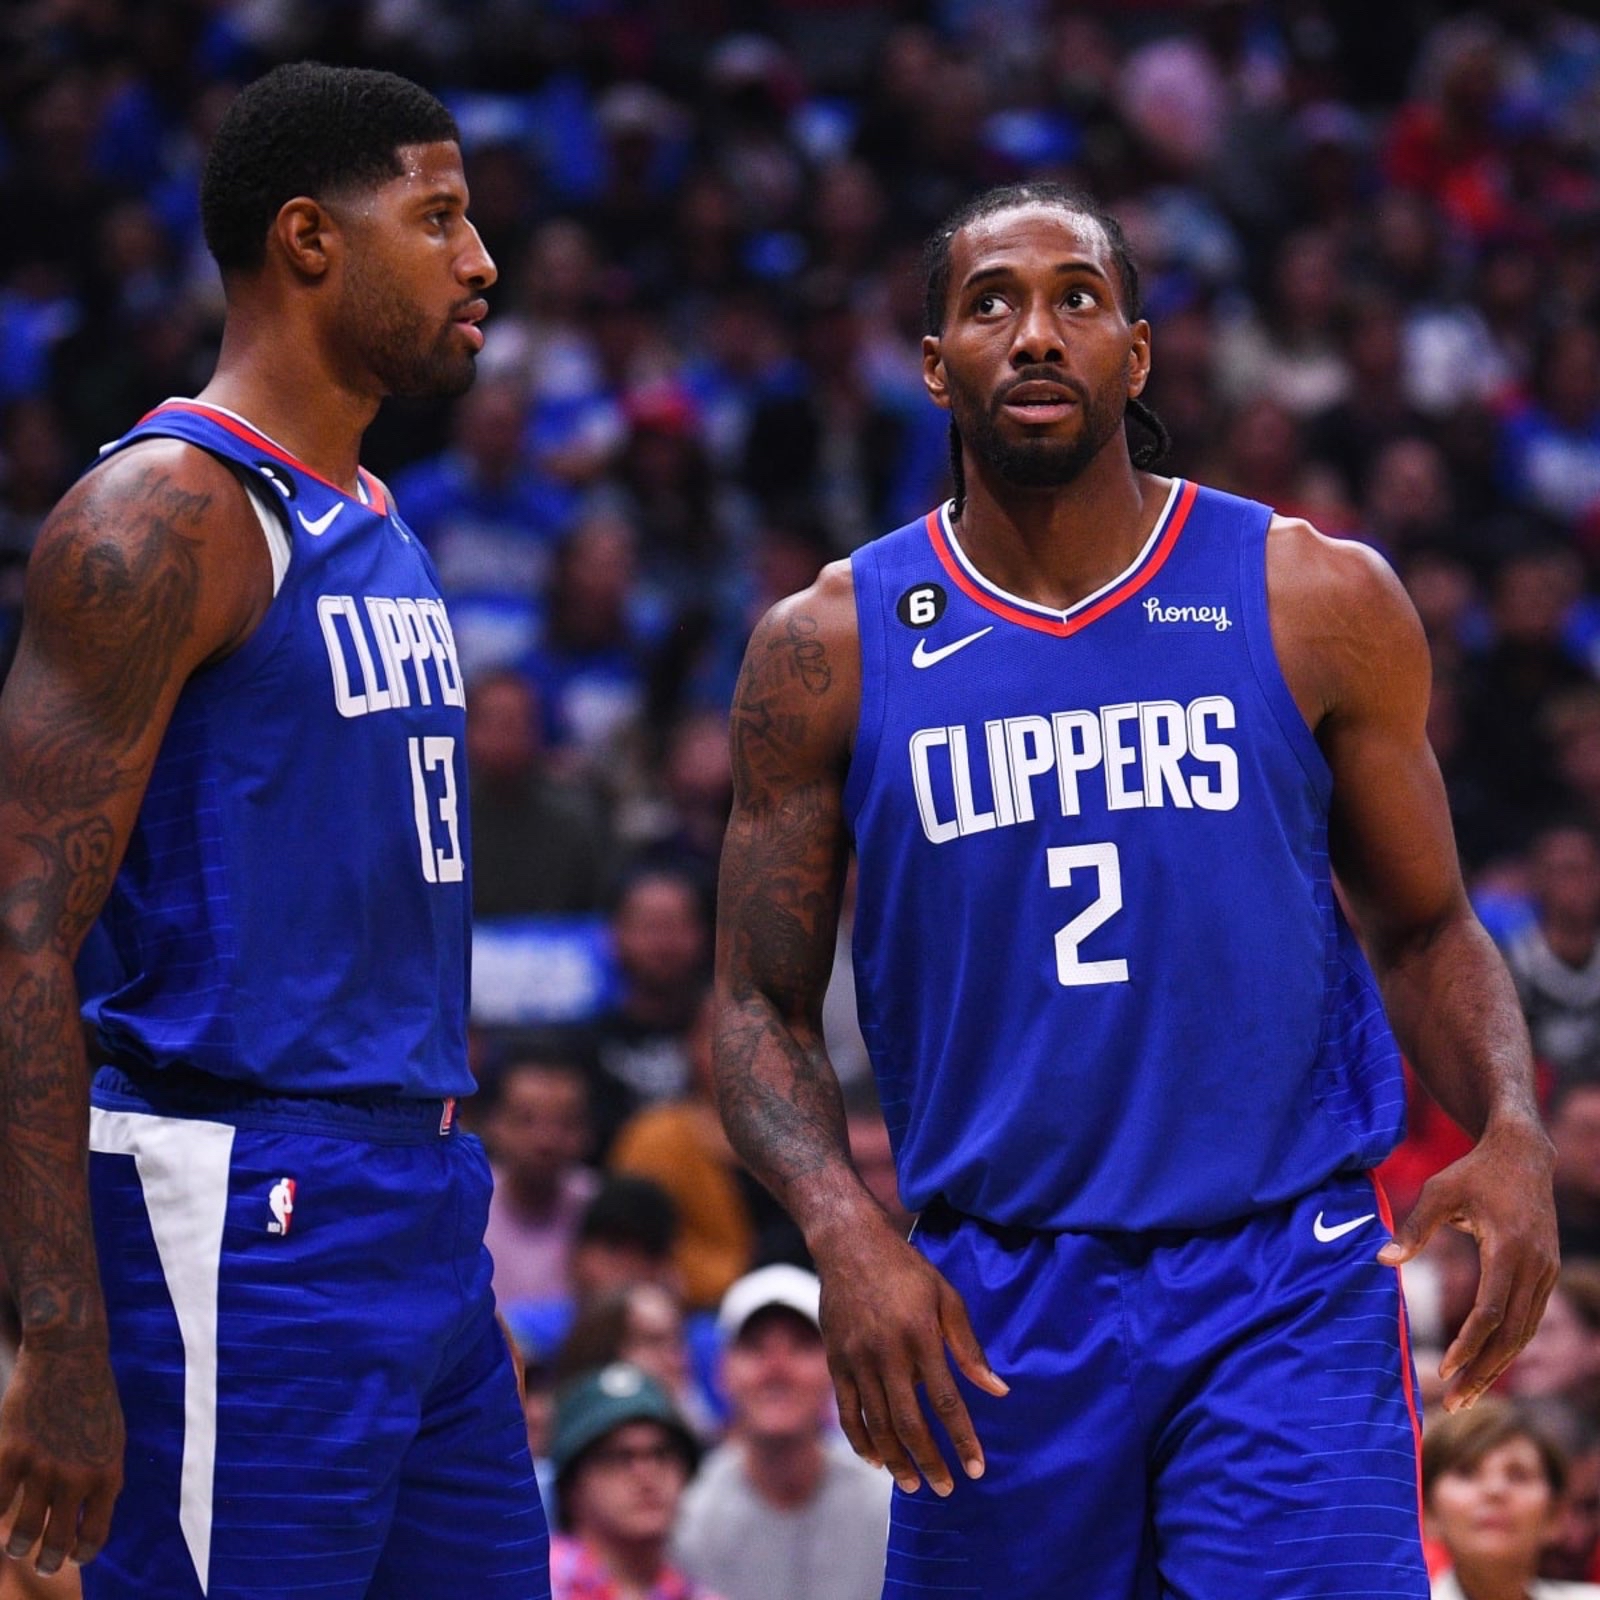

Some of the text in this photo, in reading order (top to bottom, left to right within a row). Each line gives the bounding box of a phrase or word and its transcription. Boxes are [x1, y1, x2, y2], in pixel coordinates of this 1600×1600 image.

[909, 588, 936, 623] 6
[1142, 597, 1233, 632] honey
[408, 736, 464, 883] 13
[909, 695, 1240, 844] CLIPPERS
[1046, 842, 1129, 986] 2
